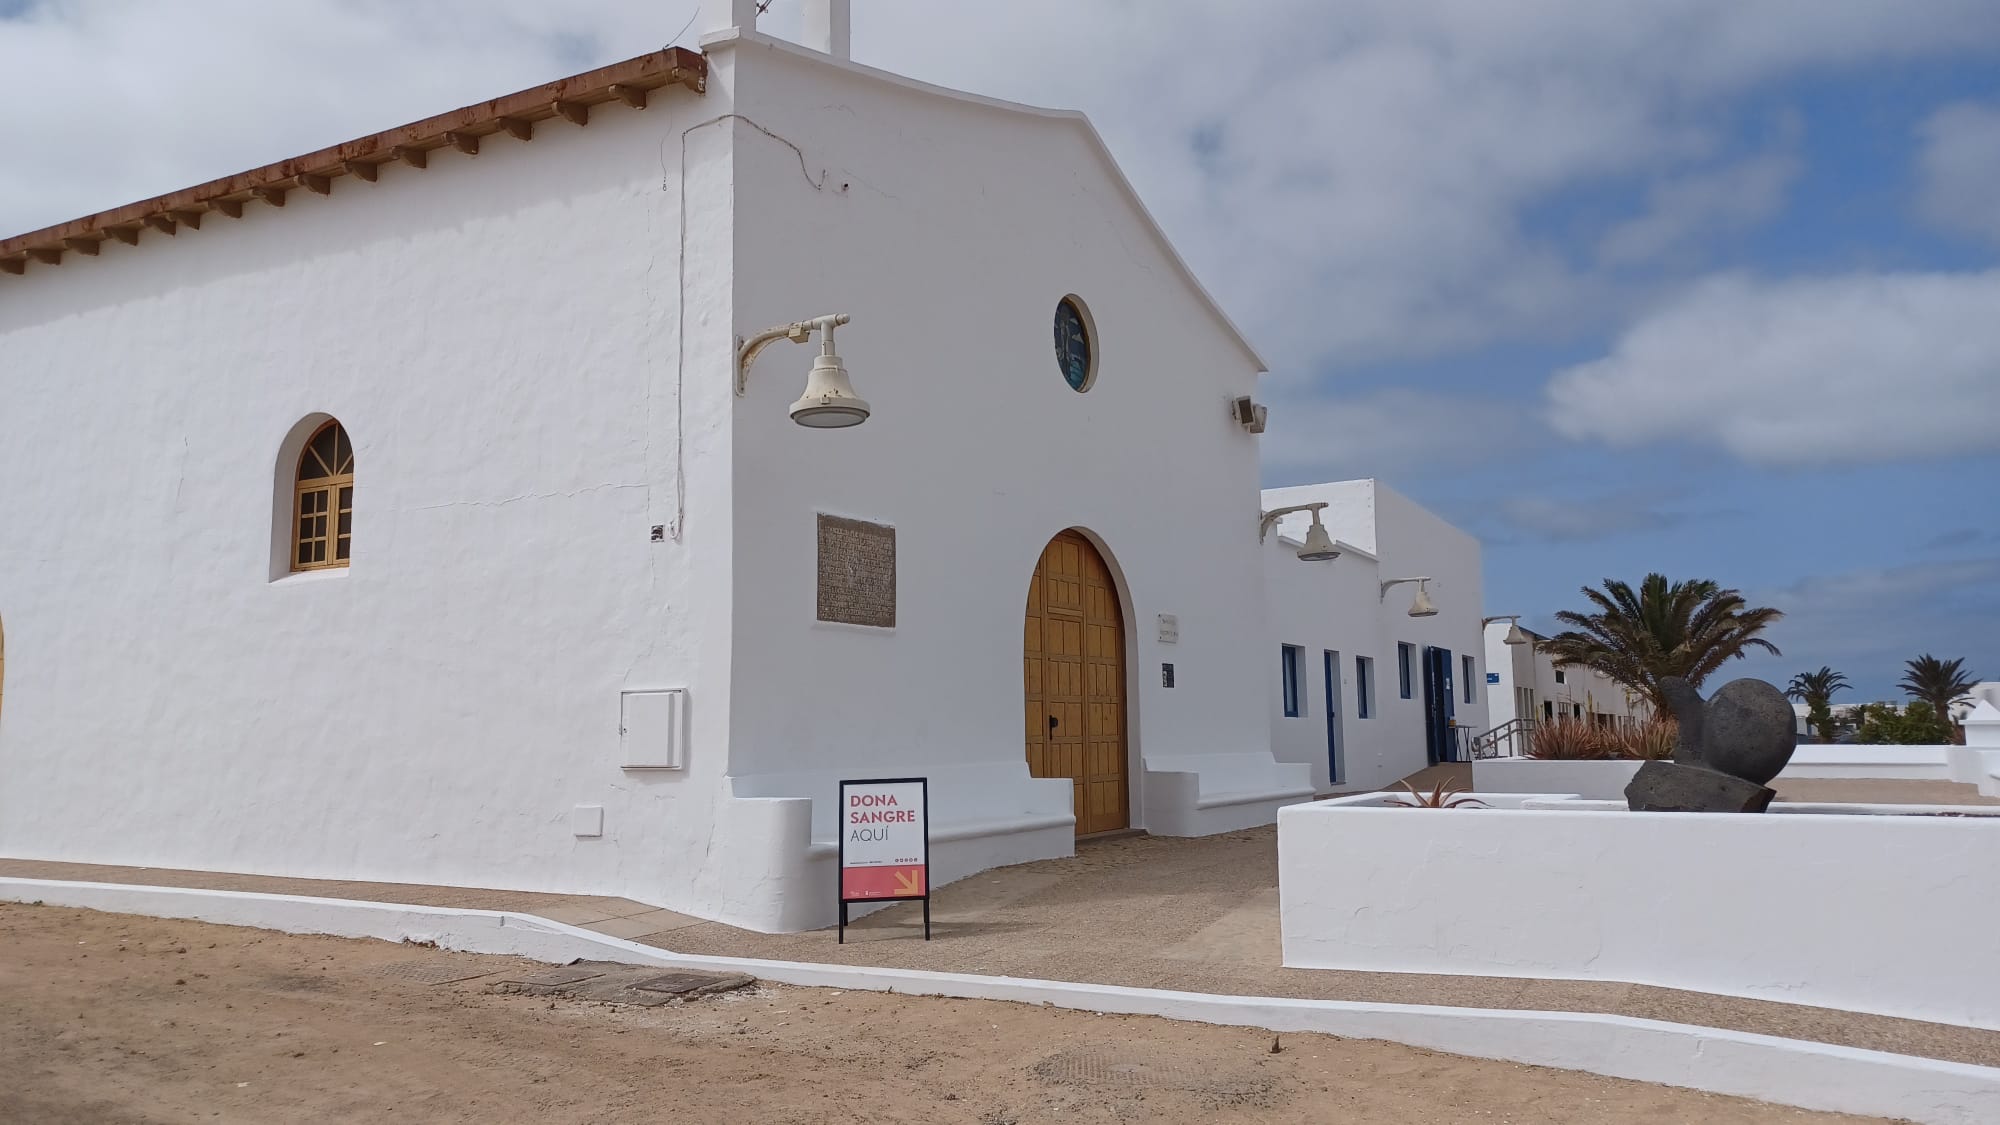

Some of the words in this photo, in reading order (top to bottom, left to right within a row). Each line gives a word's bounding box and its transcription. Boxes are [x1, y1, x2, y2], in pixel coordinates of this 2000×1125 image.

[850, 794, 898, 807] DONA
[850, 810, 915, 824] SANGRE
[850, 825, 889, 842] AQUÍ
